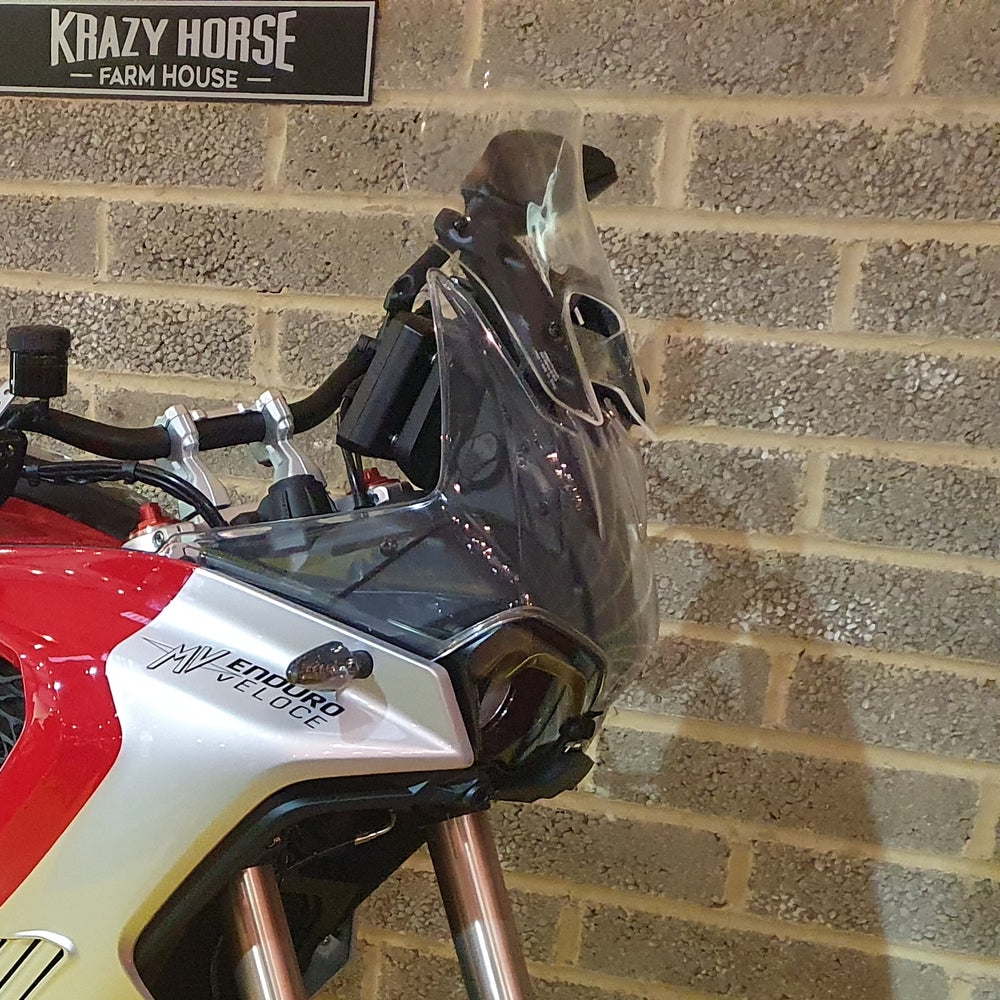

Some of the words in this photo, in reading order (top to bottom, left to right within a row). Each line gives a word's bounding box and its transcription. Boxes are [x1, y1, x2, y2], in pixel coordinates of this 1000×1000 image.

[50, 8, 168, 67] KRAZY
[177, 10, 297, 72] HORSE
[100, 65, 156, 86] FARM
[162, 64, 238, 88] HOUSE
[216, 674, 328, 729] VELOCE
[226, 658, 345, 717] ENDURO
